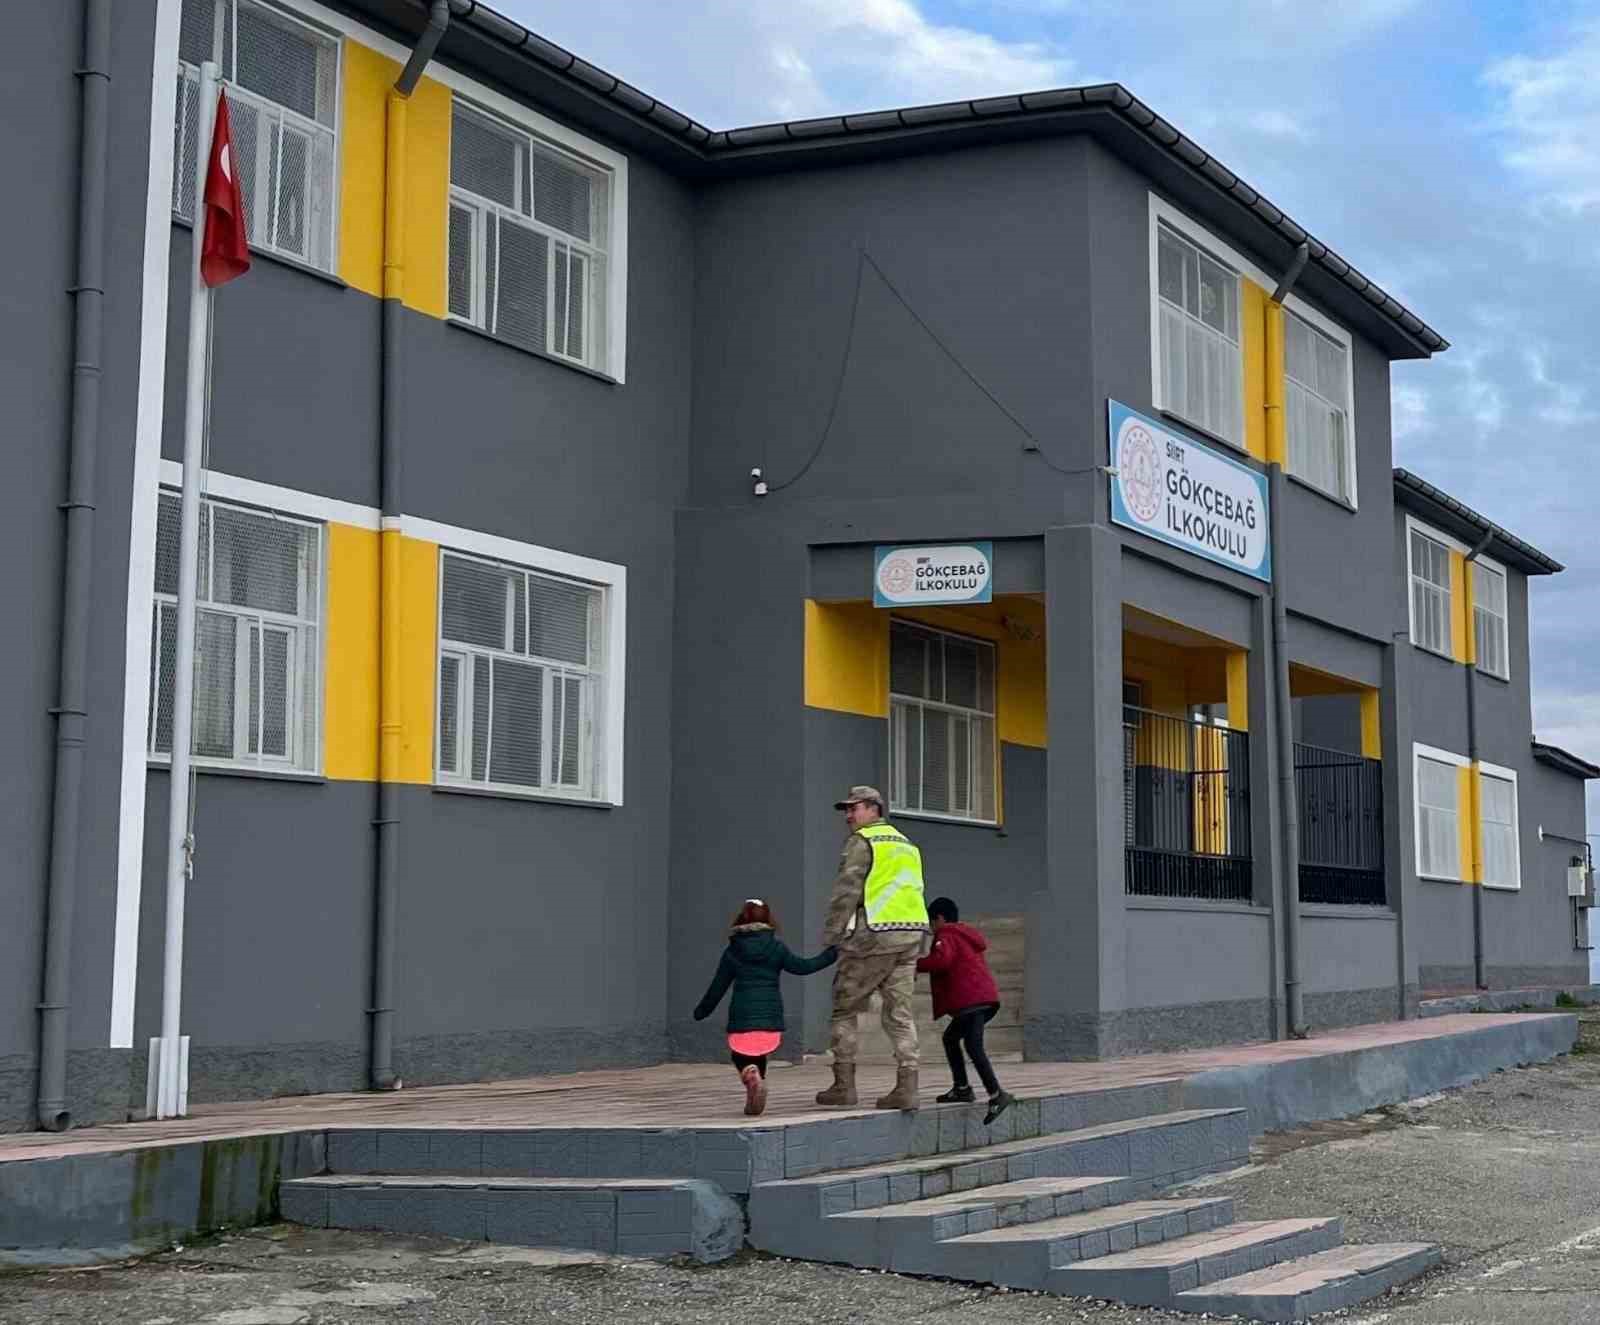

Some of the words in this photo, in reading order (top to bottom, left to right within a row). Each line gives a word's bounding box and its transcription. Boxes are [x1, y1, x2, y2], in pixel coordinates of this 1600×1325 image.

[1166, 468, 1256, 529] GÖKÇEBAĞ
[1166, 498, 1247, 559] İLKOKULU
[915, 562, 986, 578] GÖKÇEBAĞ
[915, 579, 977, 591] İLKOKULU
